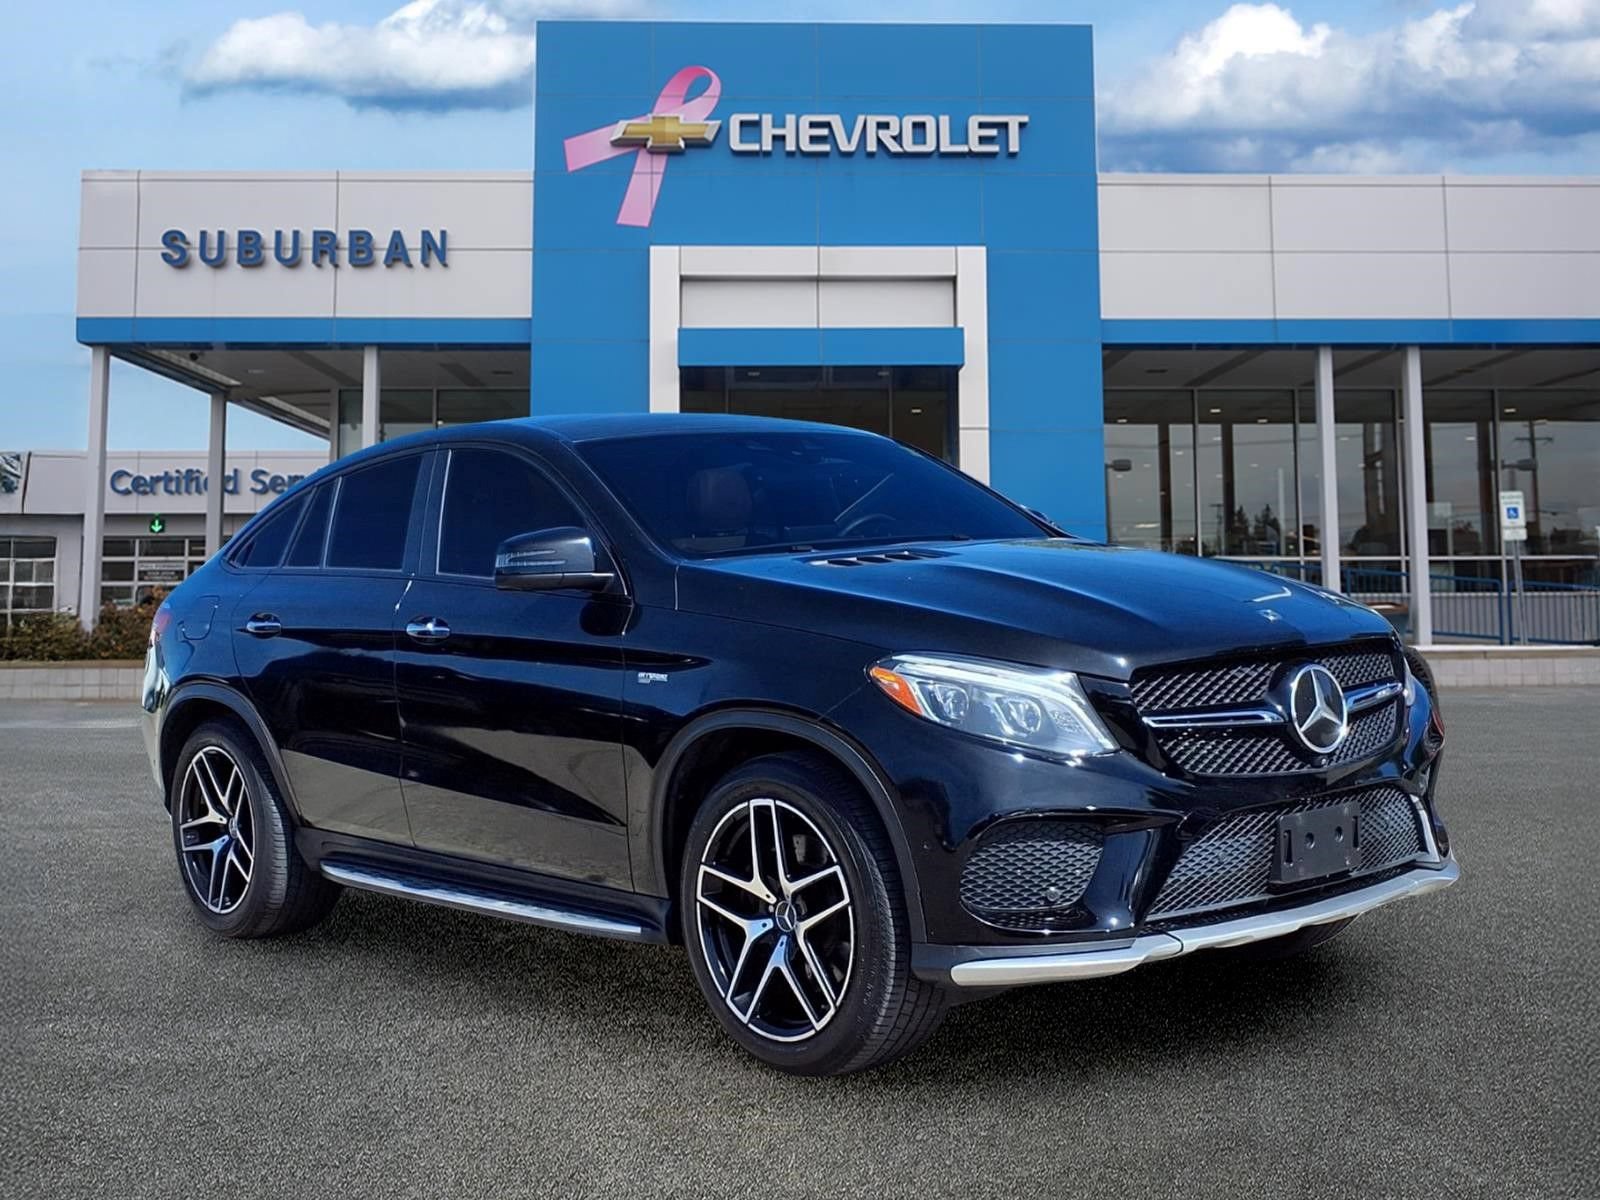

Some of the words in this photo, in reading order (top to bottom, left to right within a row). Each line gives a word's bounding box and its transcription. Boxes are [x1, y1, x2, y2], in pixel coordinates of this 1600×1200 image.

[728, 112, 1029, 156] CHEVROLET
[160, 229, 449, 268] SUBURBAN
[249, 469, 305, 495] Ser
